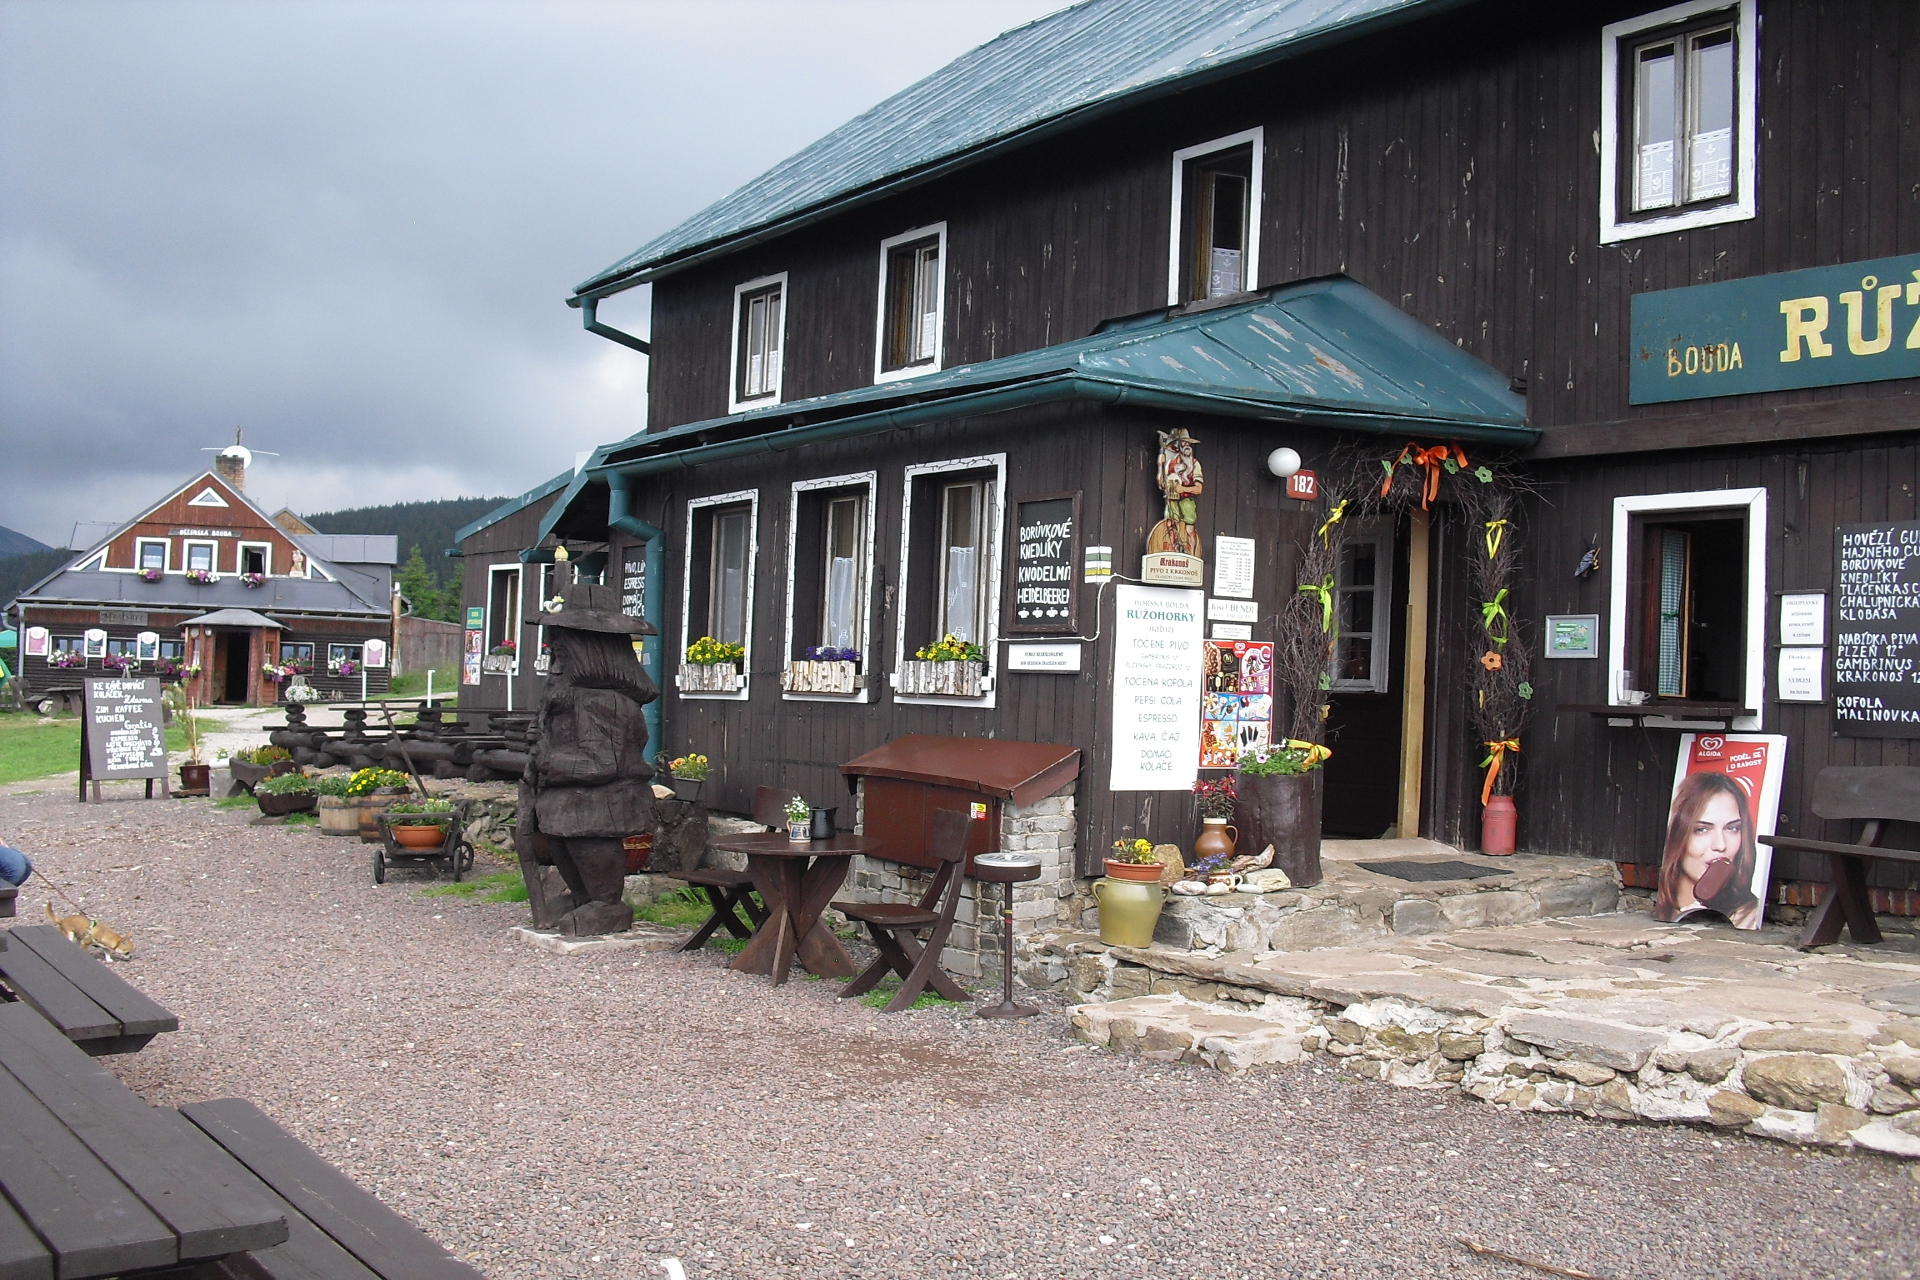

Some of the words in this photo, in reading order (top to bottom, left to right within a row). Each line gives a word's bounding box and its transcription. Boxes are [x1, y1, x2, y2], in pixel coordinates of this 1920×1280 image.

[1780, 270, 1920, 363] RŮ
[1667, 342, 1742, 377] BOUDA
[1293, 474, 1314, 494] 182
[1020, 517, 1072, 542] BORŮVKOVÉ
[1842, 528, 1894, 546] HOVĚZÍ
[1020, 539, 1062, 560] KNEDLÍKY
[1841, 556, 1906, 571] BORŮVKOVÉ
[1840, 569, 1898, 584] KNEDLÍKY
[1126, 608, 1196, 622] RŮŽOHORKY
[1838, 631, 1888, 645] NABÍDKA
[1891, 633, 1918, 644] PIVA
[1170, 640, 1188, 650] PIVO
[1838, 645, 1877, 657] PLZEŇ
[1836, 658, 1912, 670] GAMBRINUS
[1836, 670, 1904, 682] KRAKONOŠ
[93, 682, 103, 690] KE
[1162, 678, 1192, 688] KOFOLA
[124, 694, 153, 703] Zdarma
[1134, 696, 1156, 704] PEPSI
[1161, 696, 1182, 705] COLA
[1837, 696, 1882, 708] KOFOLA
[115, 705, 143, 713] KAFFEE
[1837, 708, 1920, 722] MALINOVKA
[96, 714, 124, 723] KUCHEN
[1139, 714, 1177, 722] ESPRESSO
[124, 720, 152, 730] Gratis
[1162, 730, 1180, 741] ČAJ
[1737, 759, 1762, 768] RADOST
